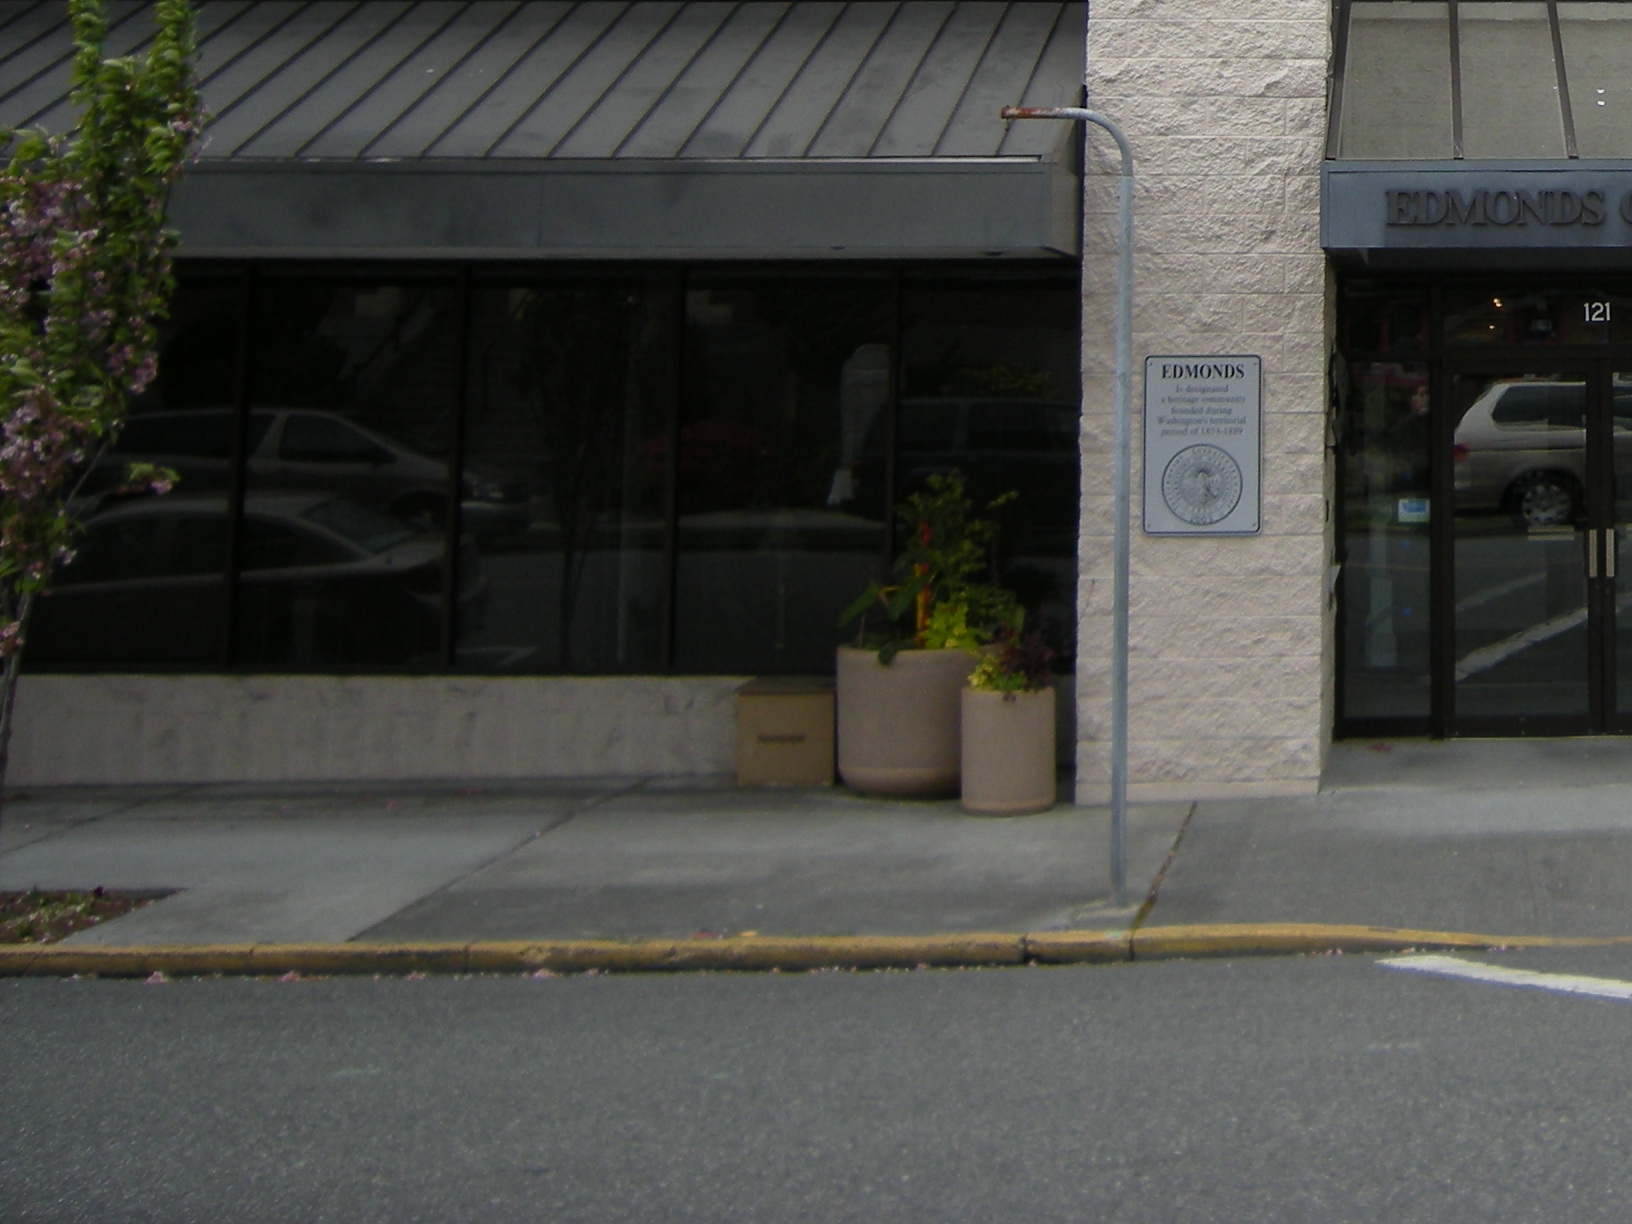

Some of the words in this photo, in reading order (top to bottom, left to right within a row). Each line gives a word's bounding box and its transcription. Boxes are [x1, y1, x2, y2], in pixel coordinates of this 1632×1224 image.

[1384, 189, 1606, 227] EDMONDS
[1583, 302, 1612, 323] 121
[1162, 364, 1245, 379] EDMONDS
[1185, 384, 1229, 394] designated
[1201, 395, 1247, 404] community
